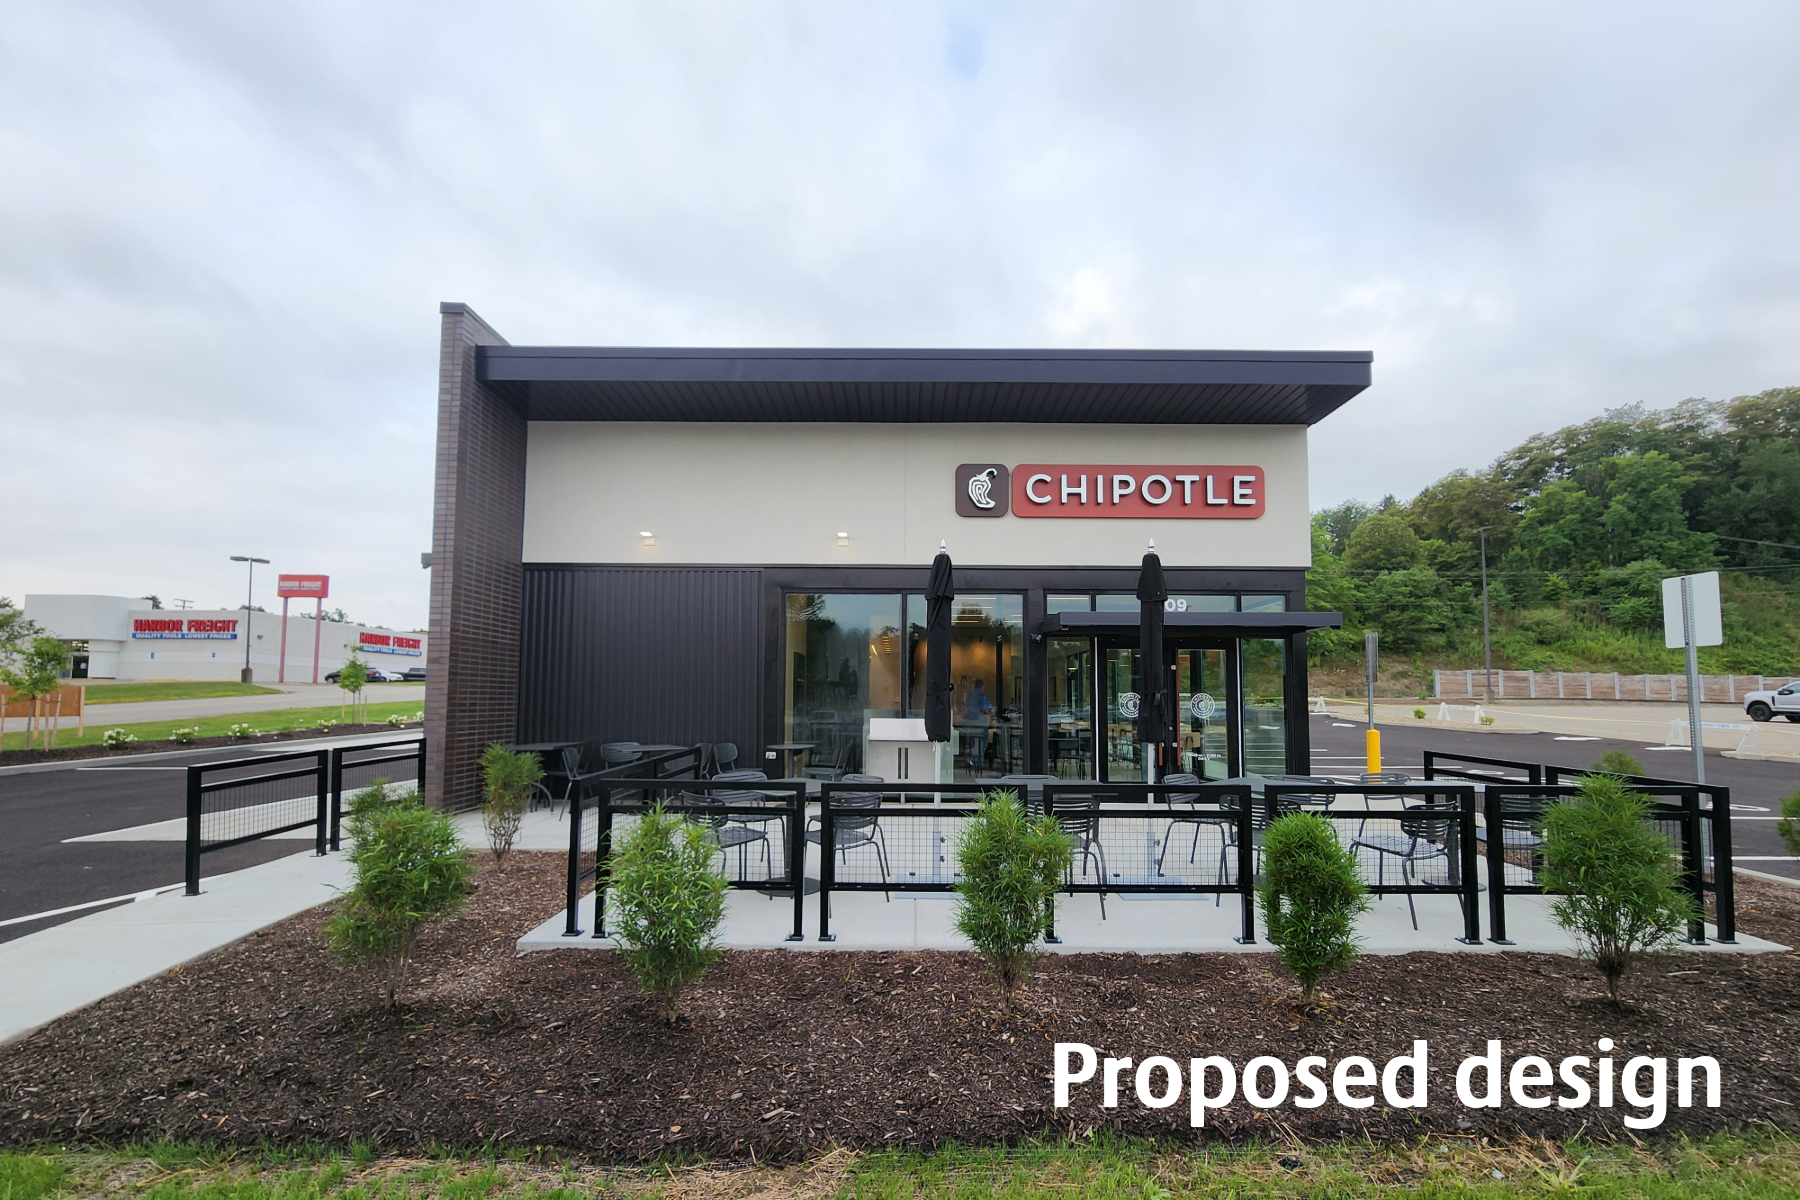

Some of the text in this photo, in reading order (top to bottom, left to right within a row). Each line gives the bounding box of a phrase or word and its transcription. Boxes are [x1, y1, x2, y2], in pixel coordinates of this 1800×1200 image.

[1025, 473, 1257, 506] CHIPOTLE
[133, 619, 238, 632] HARBOR FREIGHT
[360, 631, 422, 650] HARBOR FREIGHT
